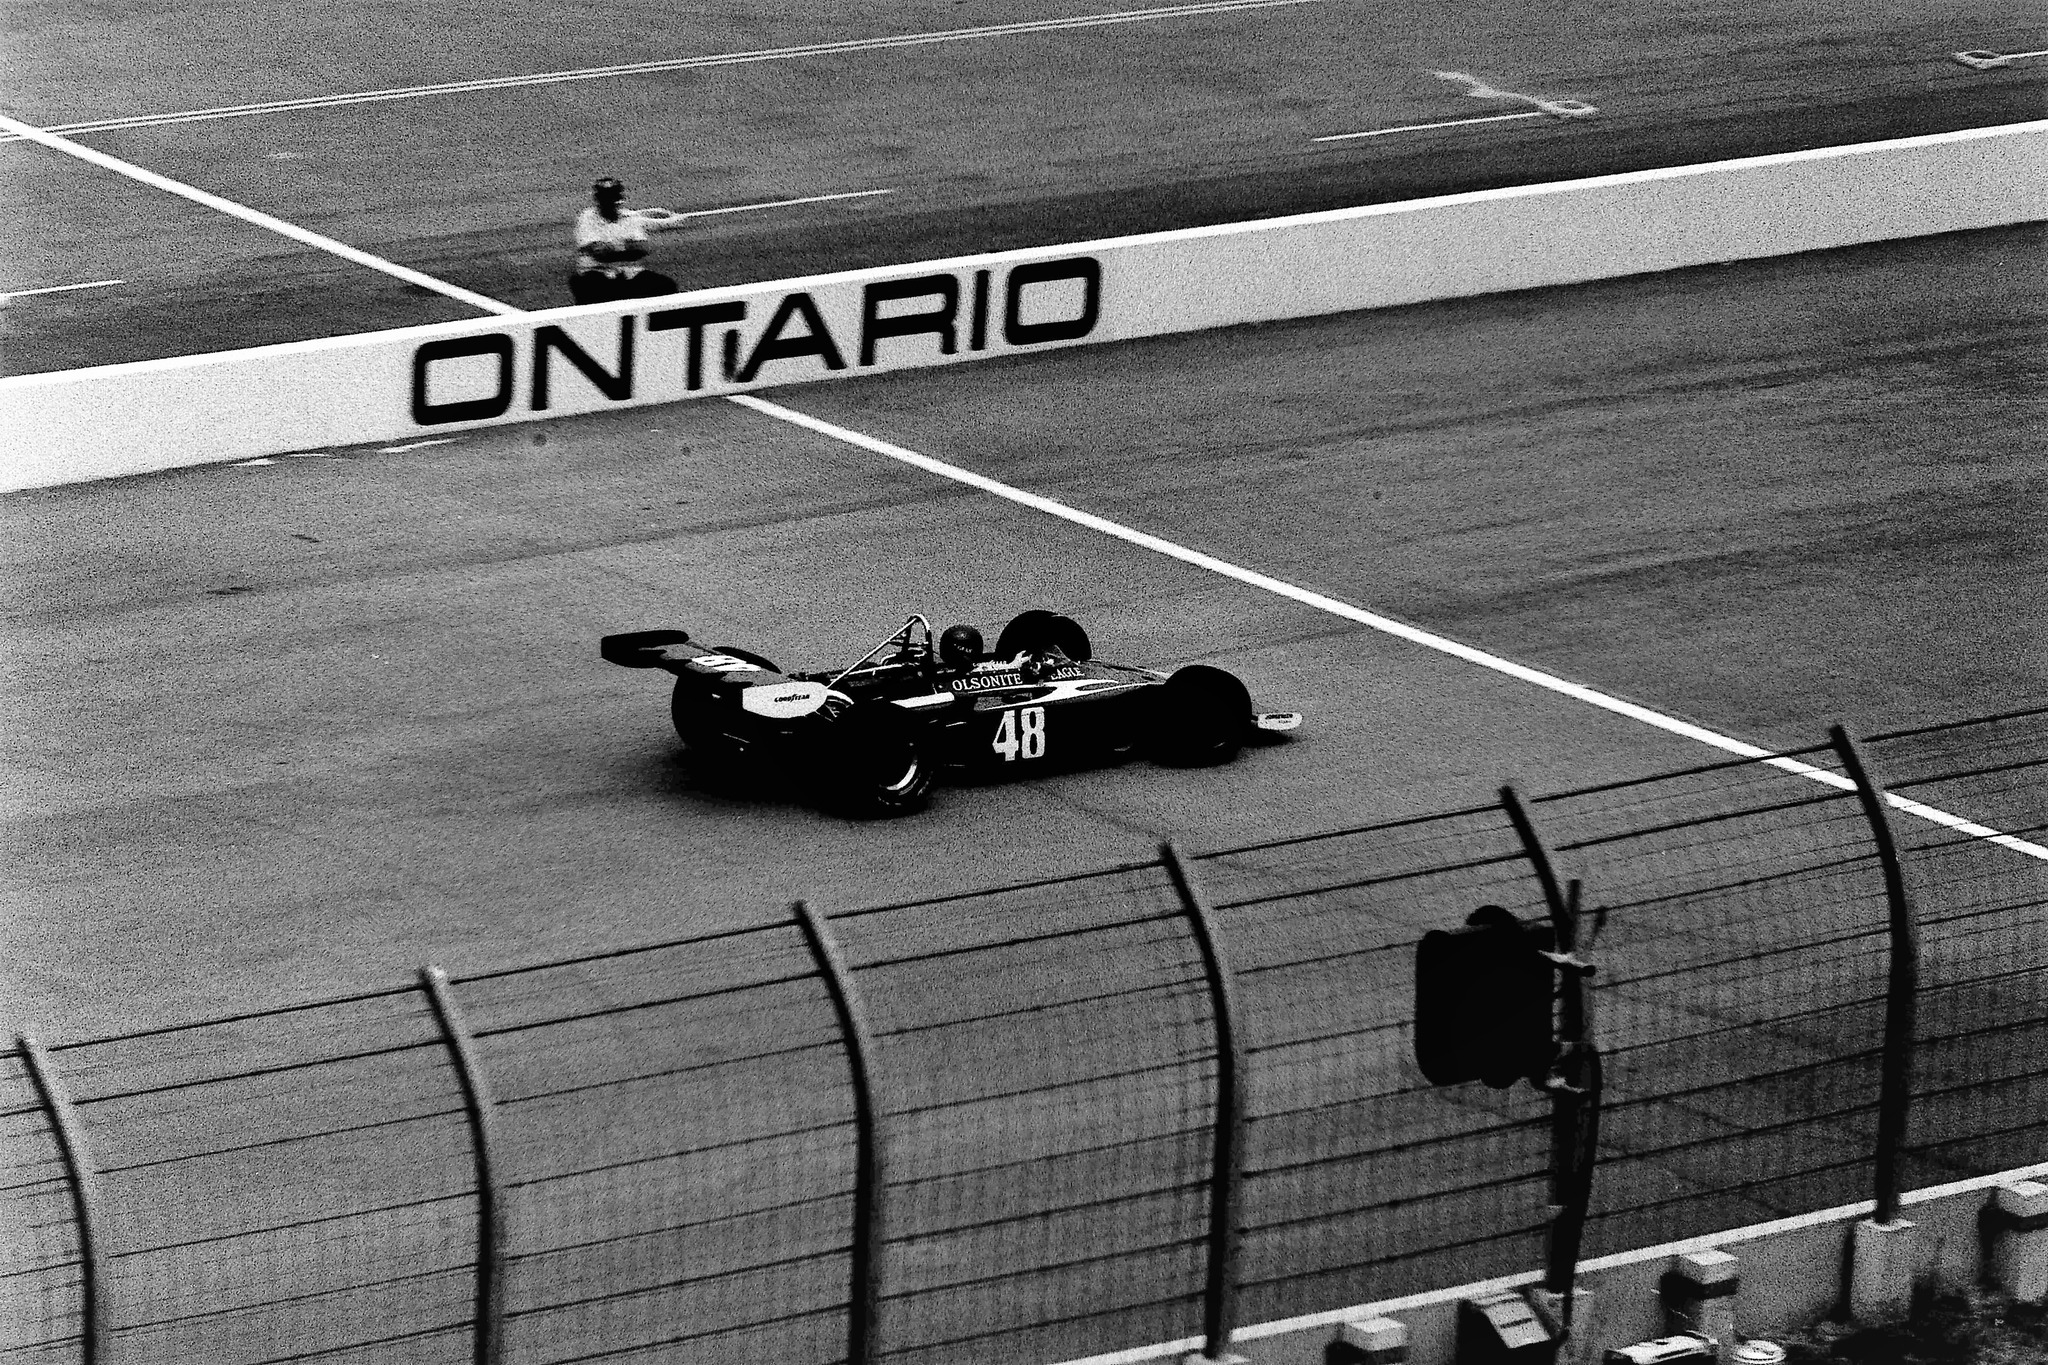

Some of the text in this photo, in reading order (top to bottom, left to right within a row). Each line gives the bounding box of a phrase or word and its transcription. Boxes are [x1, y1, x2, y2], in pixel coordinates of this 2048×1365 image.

[411, 256, 1102, 426] ONTARIO
[952, 673, 1023, 692] OLSONITE
[992, 706, 1046, 762] 48
